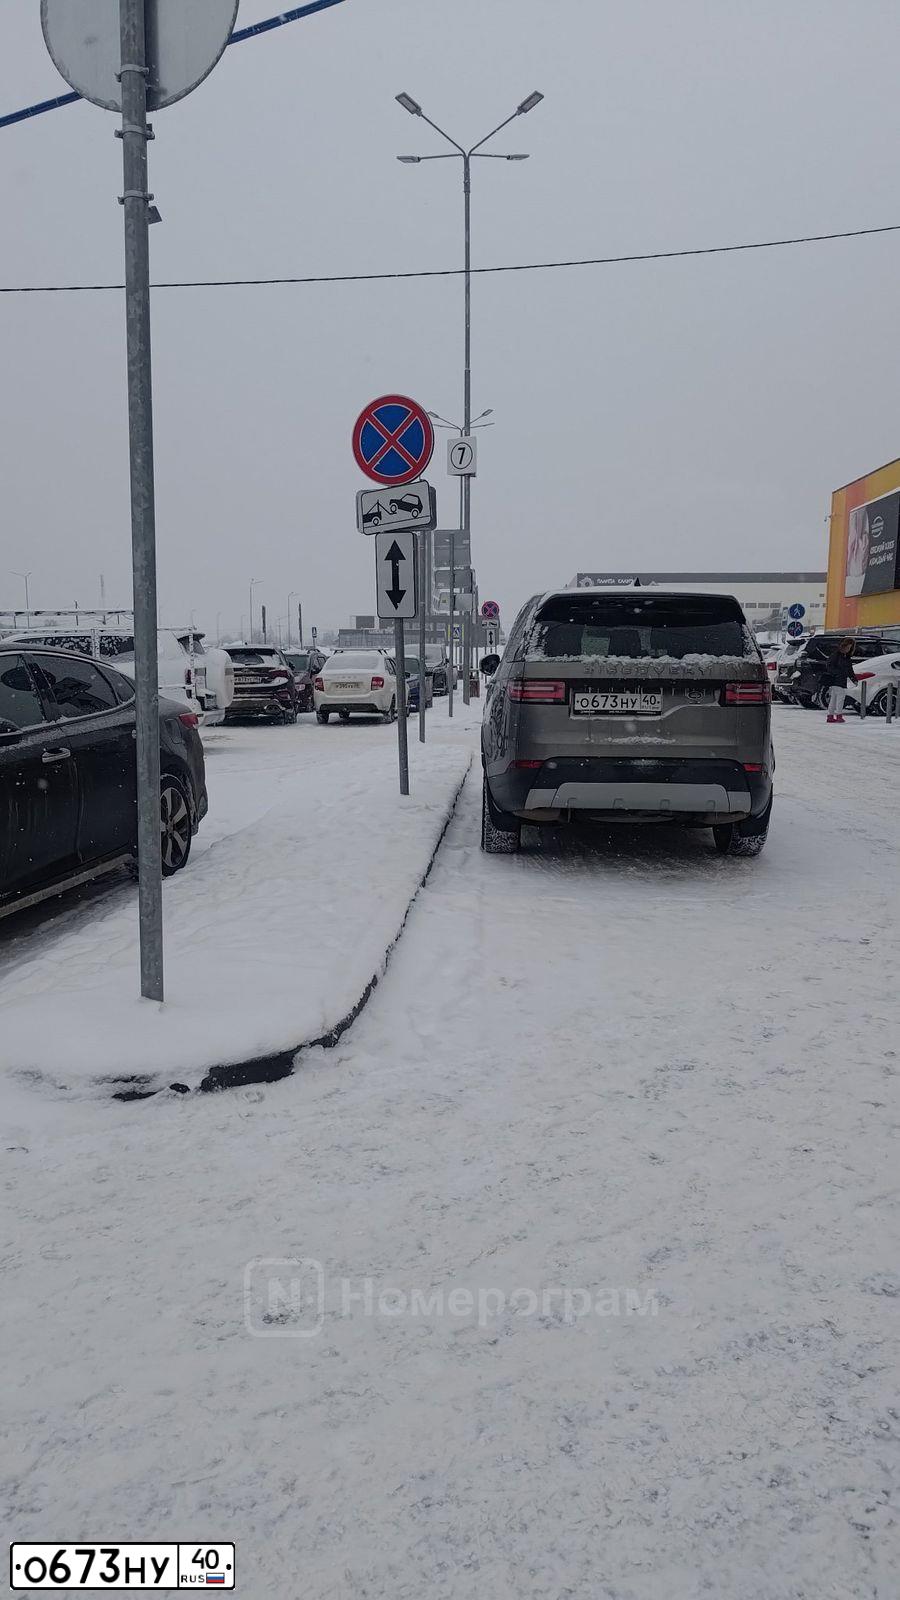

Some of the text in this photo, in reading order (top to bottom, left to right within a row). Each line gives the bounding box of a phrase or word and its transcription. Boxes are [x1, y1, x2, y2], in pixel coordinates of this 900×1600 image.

[457, 446, 466, 465] 7
[580, 694, 657, 709] О673НУ 40
